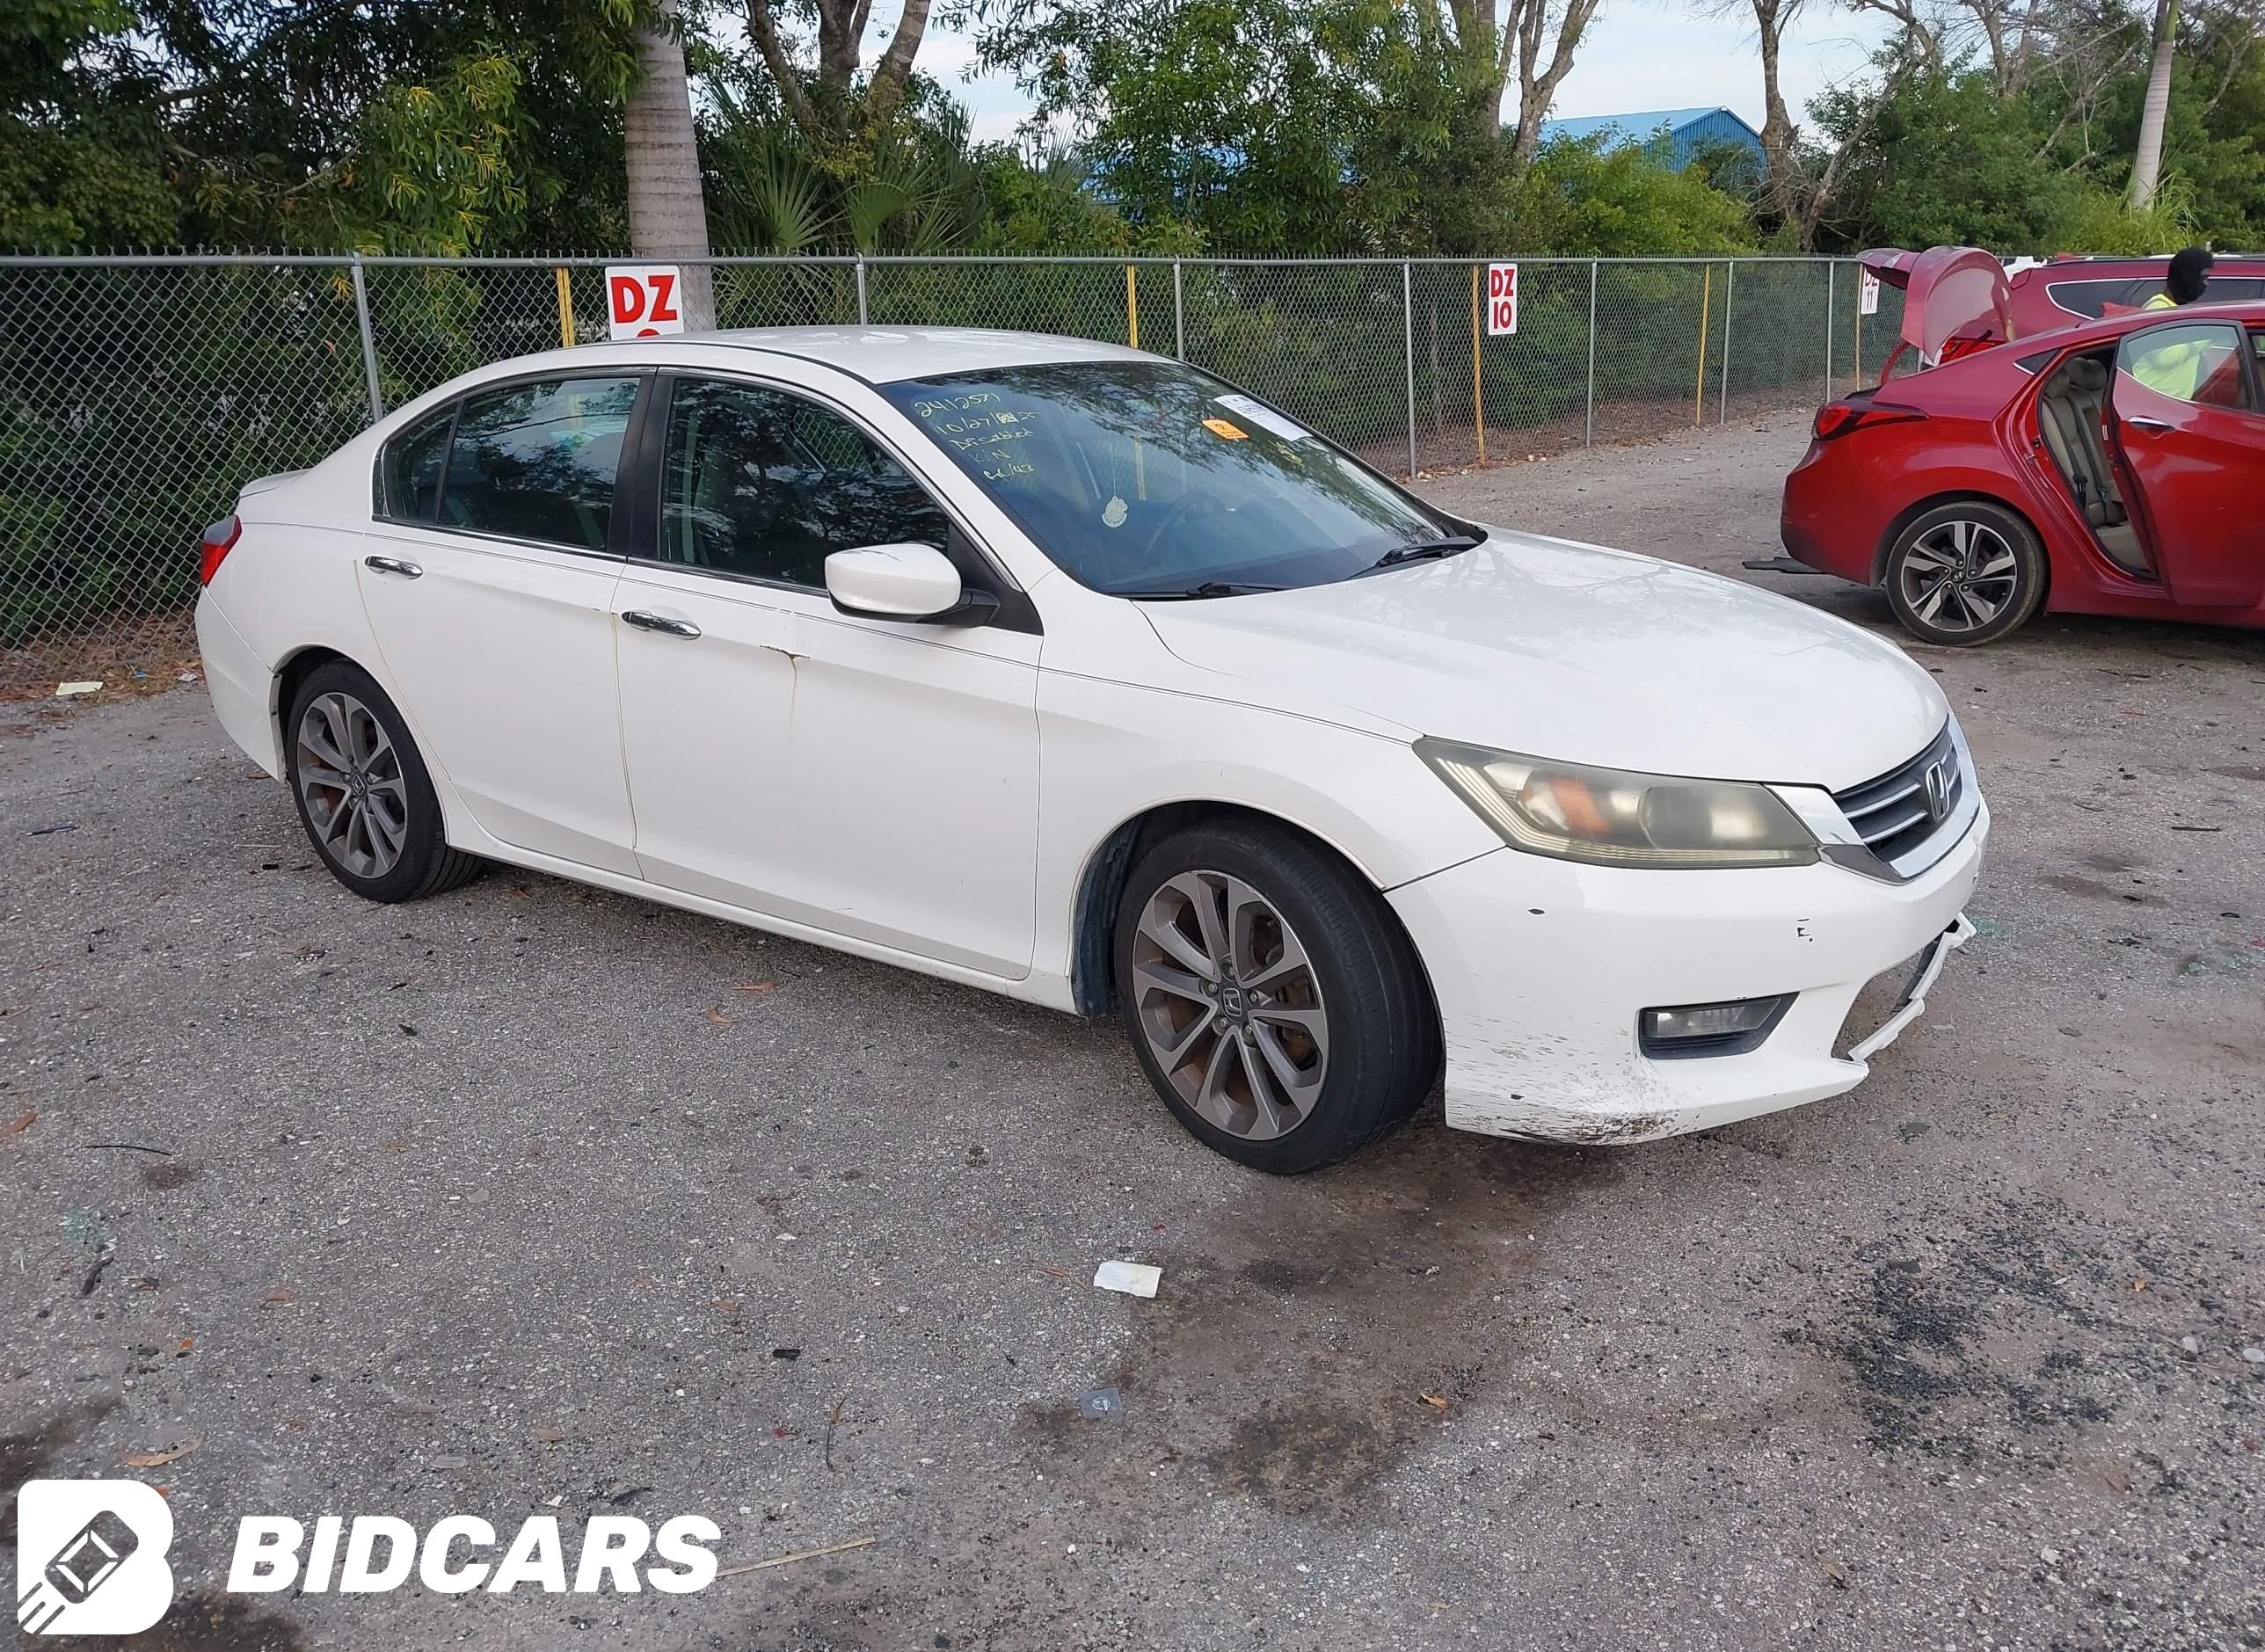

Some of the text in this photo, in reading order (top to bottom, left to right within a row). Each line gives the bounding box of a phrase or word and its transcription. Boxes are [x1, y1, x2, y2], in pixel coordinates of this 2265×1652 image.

[1490, 269, 1515, 297] DZ
[610, 274, 678, 324] DZ
[1866, 289, 1874, 310] 11
[1494, 301, 1512, 330] 10
